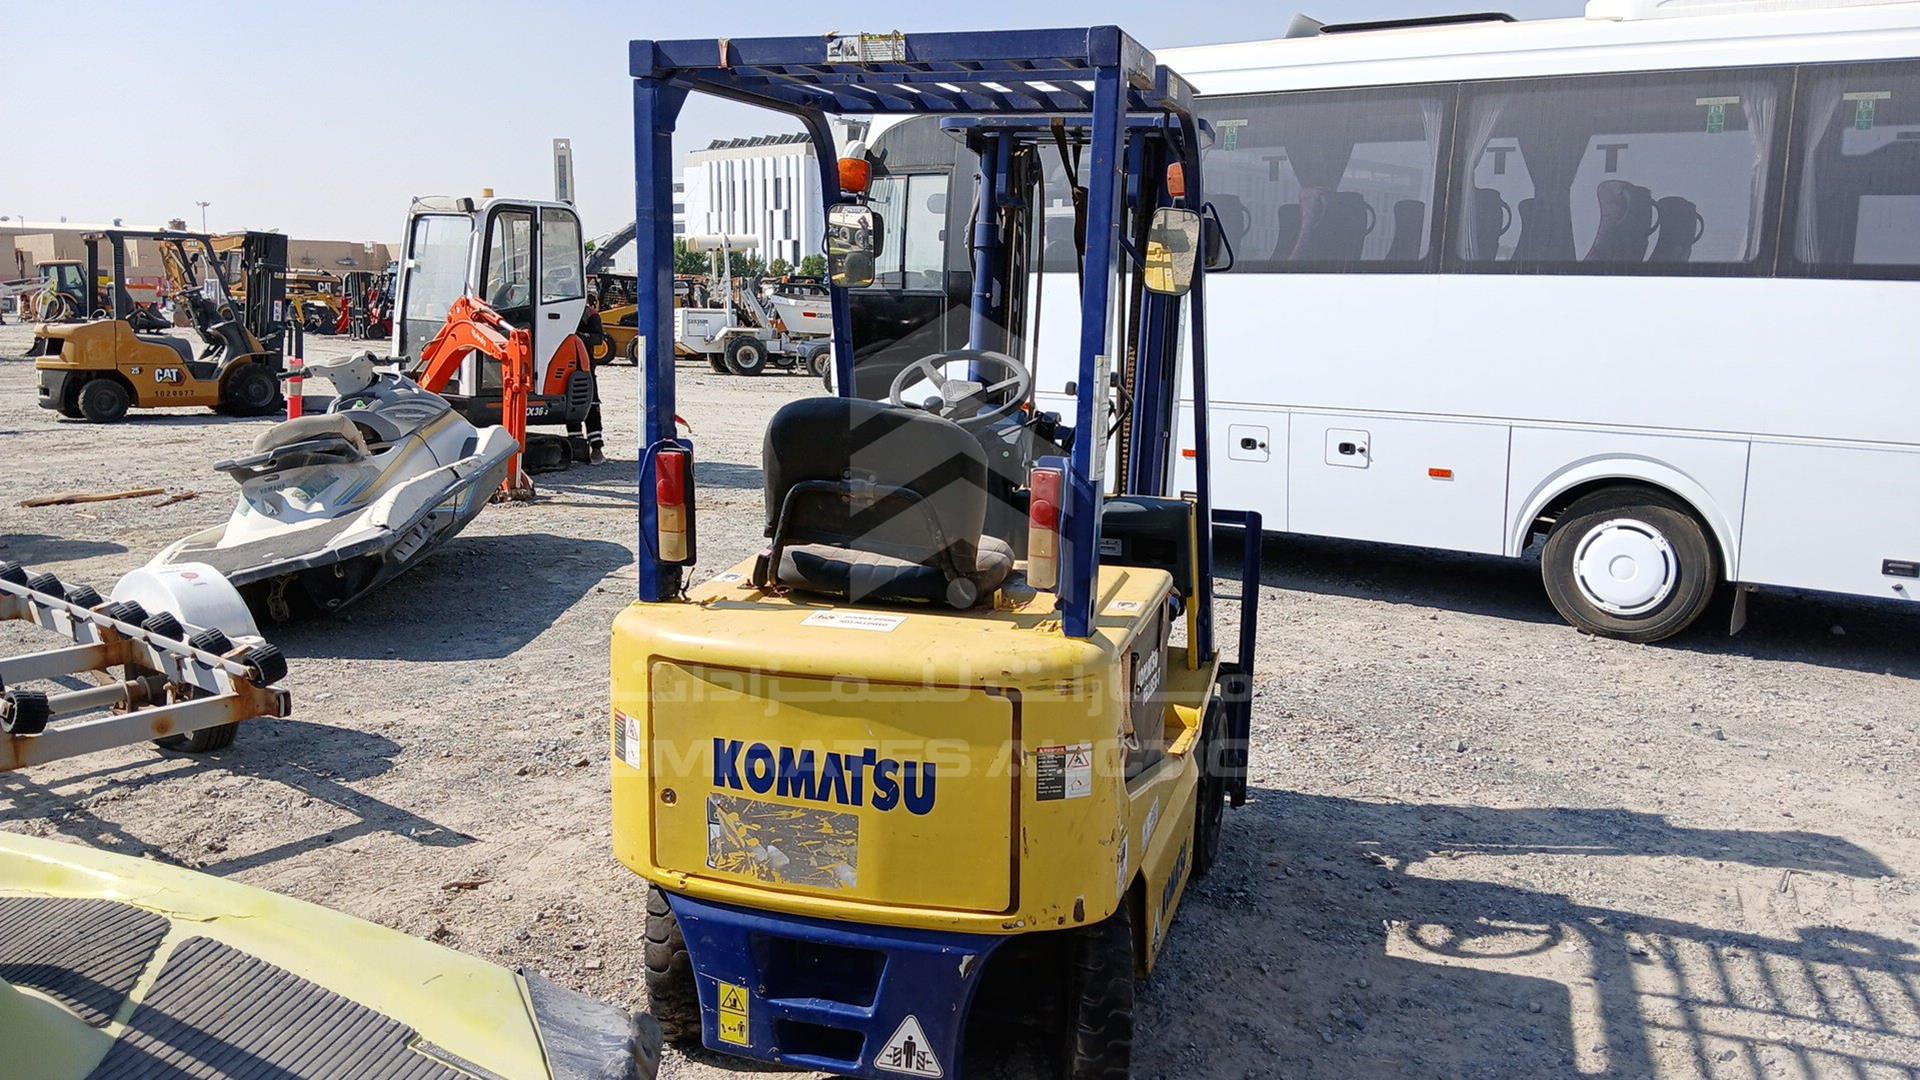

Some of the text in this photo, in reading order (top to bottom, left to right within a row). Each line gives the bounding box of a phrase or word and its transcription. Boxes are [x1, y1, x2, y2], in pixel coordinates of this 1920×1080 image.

[318, 282, 331, 294] CAT
[154, 368, 178, 383] CAT
[713, 738, 936, 815] KOMATSU
